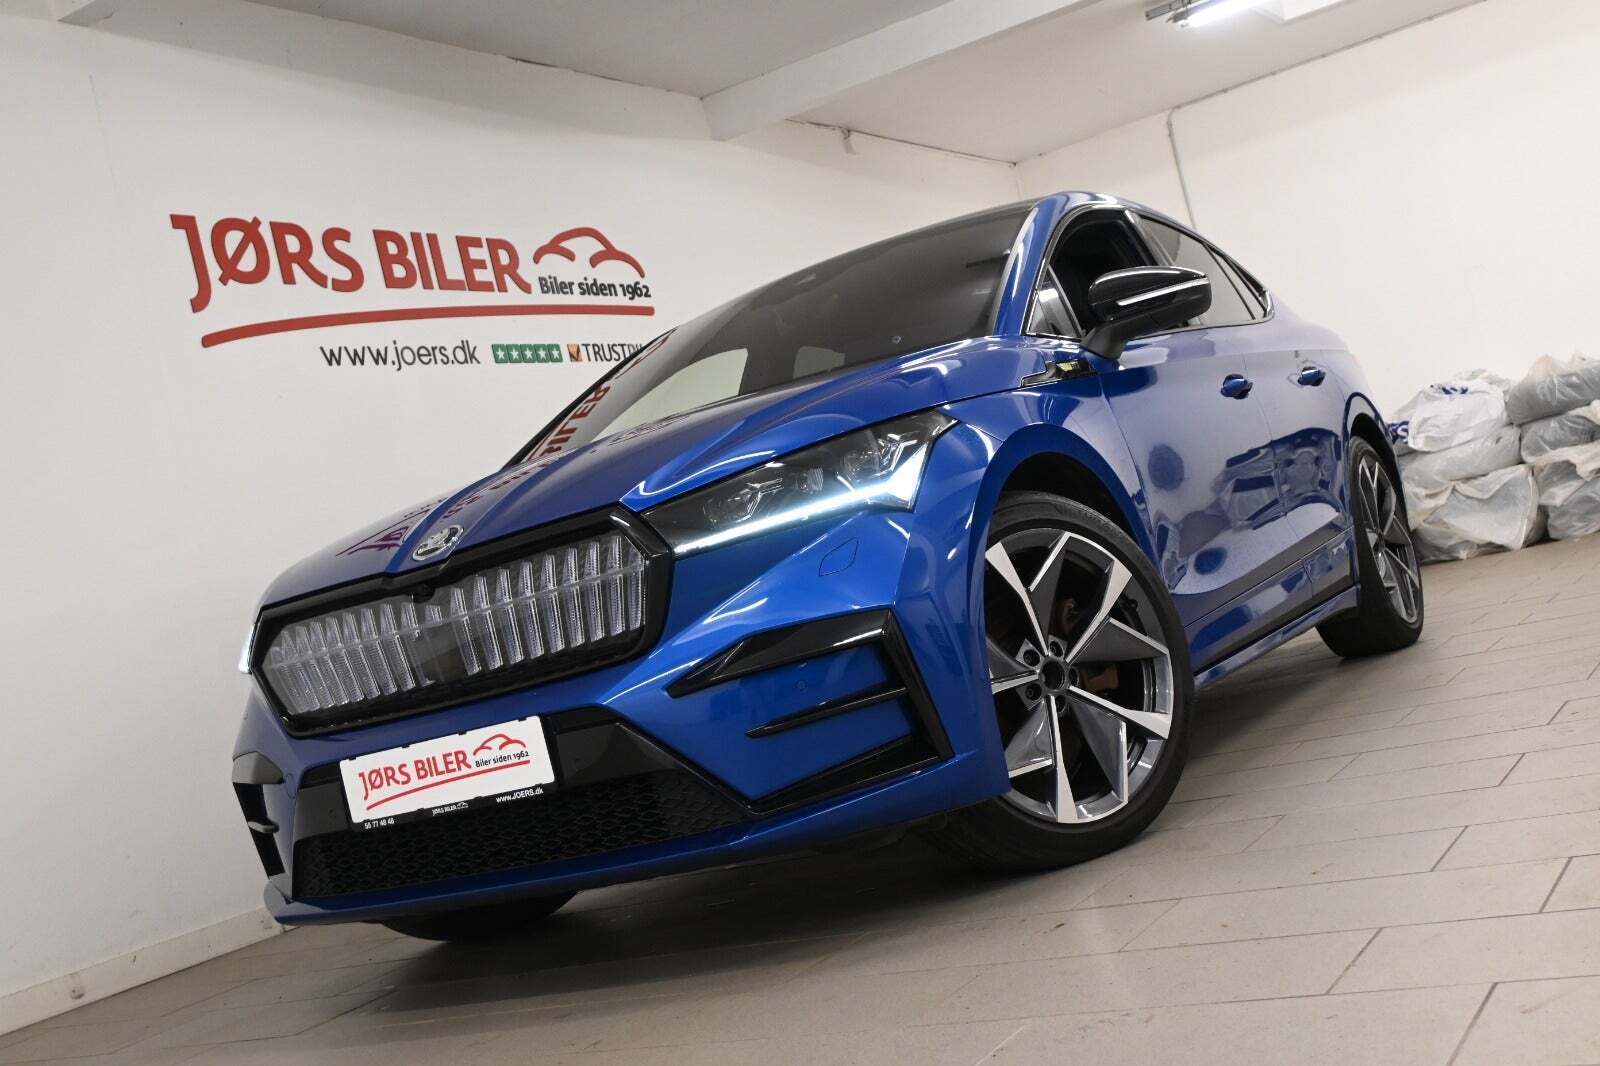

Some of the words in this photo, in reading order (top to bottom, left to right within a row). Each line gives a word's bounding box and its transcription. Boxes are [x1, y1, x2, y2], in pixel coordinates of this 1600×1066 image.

[170, 213, 364, 314] JØRS
[372, 228, 532, 294] BILER
[538, 275, 575, 295] Biler
[577, 276, 618, 297] siden
[619, 281, 651, 301] 1962
[319, 339, 481, 371] www.joers.dk
[475, 758, 491, 768] Biler
[492, 754, 512, 764] siden
[512, 750, 530, 760] 1962
[358, 763, 411, 801] JØRS
[413, 750, 472, 780] BILER
